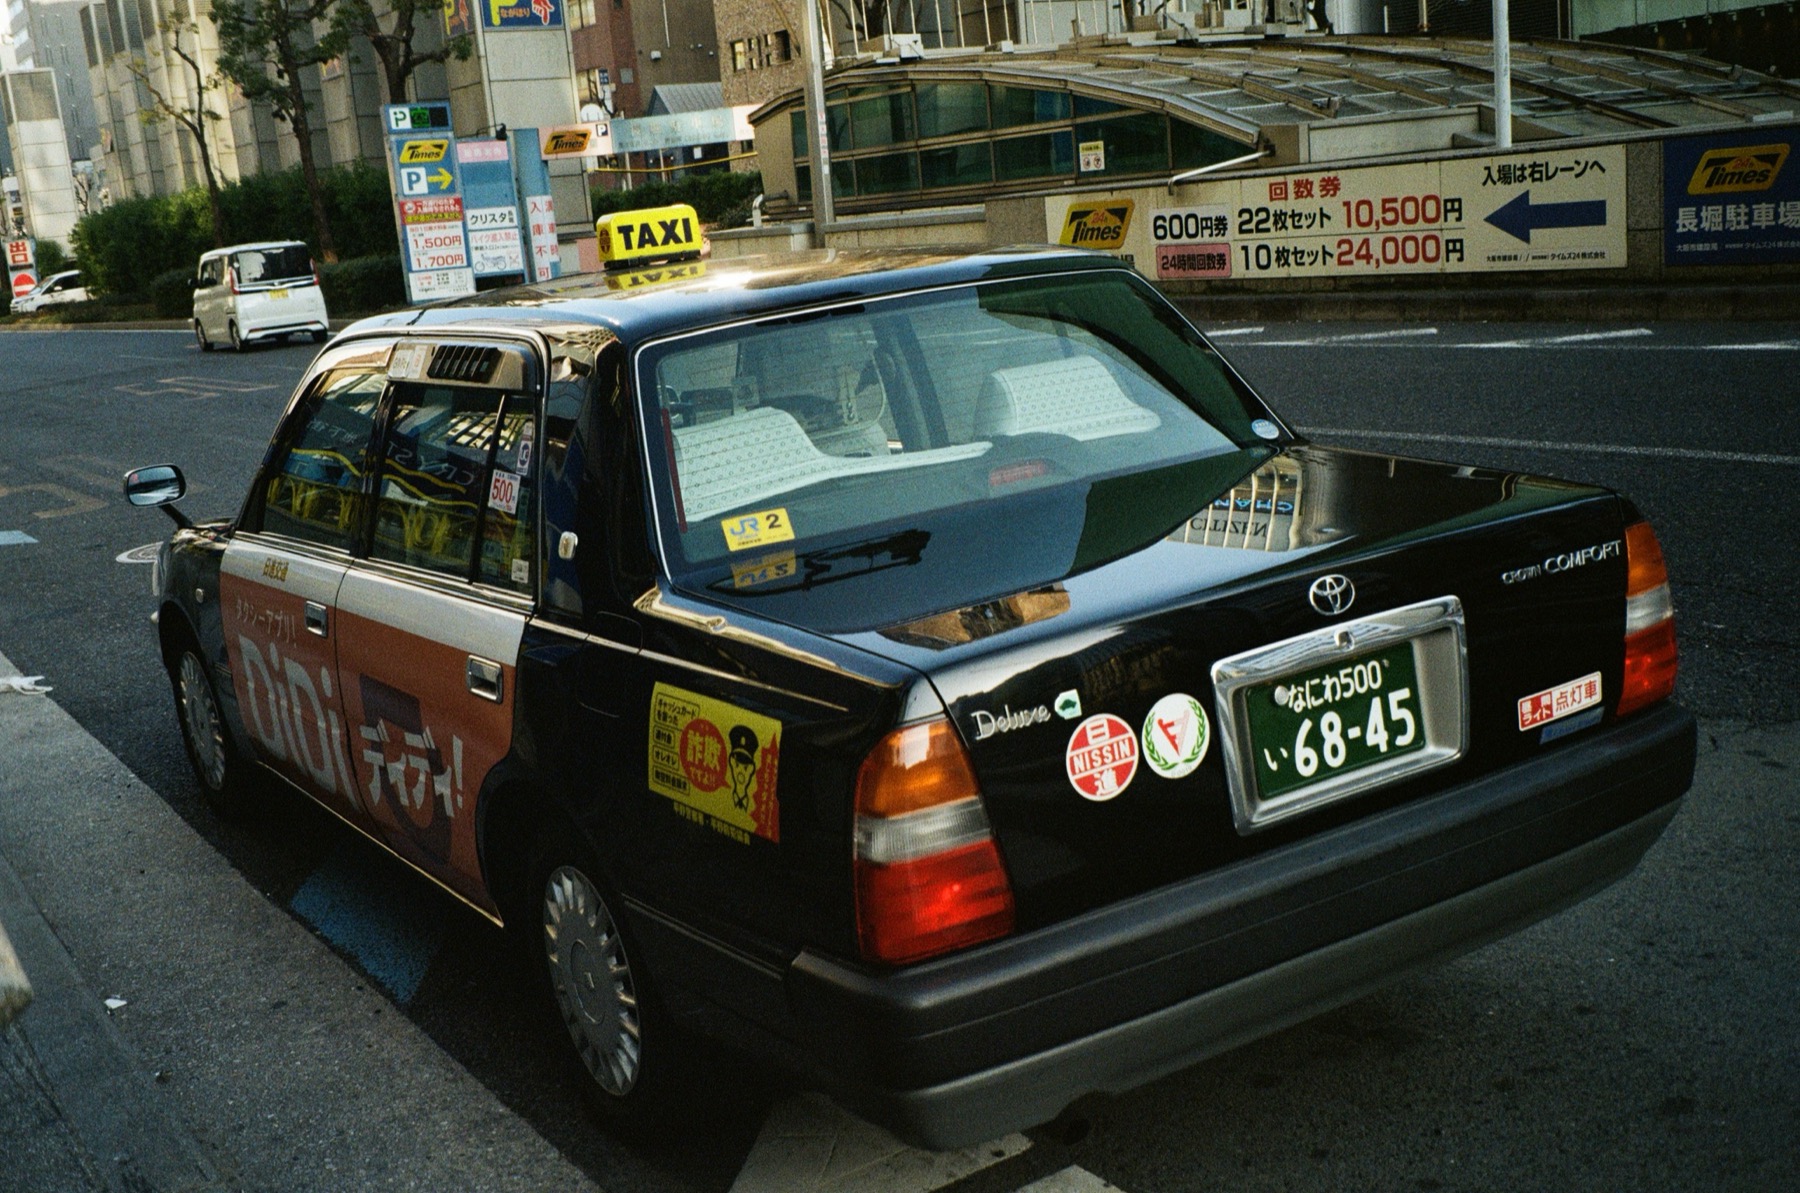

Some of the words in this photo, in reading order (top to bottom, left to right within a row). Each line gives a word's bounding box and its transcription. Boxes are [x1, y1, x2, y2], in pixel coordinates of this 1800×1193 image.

[410, 149, 441, 160] Times
[553, 137, 585, 150] Times
[406, 171, 422, 191] P
[1482, 159, 1606, 186] 入場は右レーンへ
[1704, 166, 1772, 188] Times
[1269, 176, 1341, 201] 回数券
[470, 212, 507, 225] クリスタ
[1153, 213, 1228, 240] 600円券
[1238, 206, 1332, 235] 22枚セット
[1342, 194, 1463, 231] 10,500円
[1676, 202, 1800, 233] 長堀駐車場
[413, 235, 462, 250] 1,500円
[617, 217, 694, 251] TAXI
[1071, 221, 1122, 244] Times
[9, 241, 29, 264] 出口
[416, 253, 464, 269] 1,700円
[1161, 252, 1227, 271] 24時間回数券
[1240, 243, 1334, 270] 10枚セット
[1336, 234, 1465, 269] 24,000円
[491, 477, 514, 504] 500
[730, 516, 760, 536] JR
[765, 513, 783, 529] 2
[1544, 540, 1622, 573] COMFORT
[1555, 680, 1598, 713] 点灯車
[239, 634, 362, 814] DiDi
[971, 704, 1052, 741] Deluxe
[1522, 704, 1552, 726] ライト
[1263, 746, 1288, 771] い
[1295, 687, 1416, 778] 68-45
[359, 718, 464, 818] ディディ!
[1073, 737, 1132, 775] NISSIN
